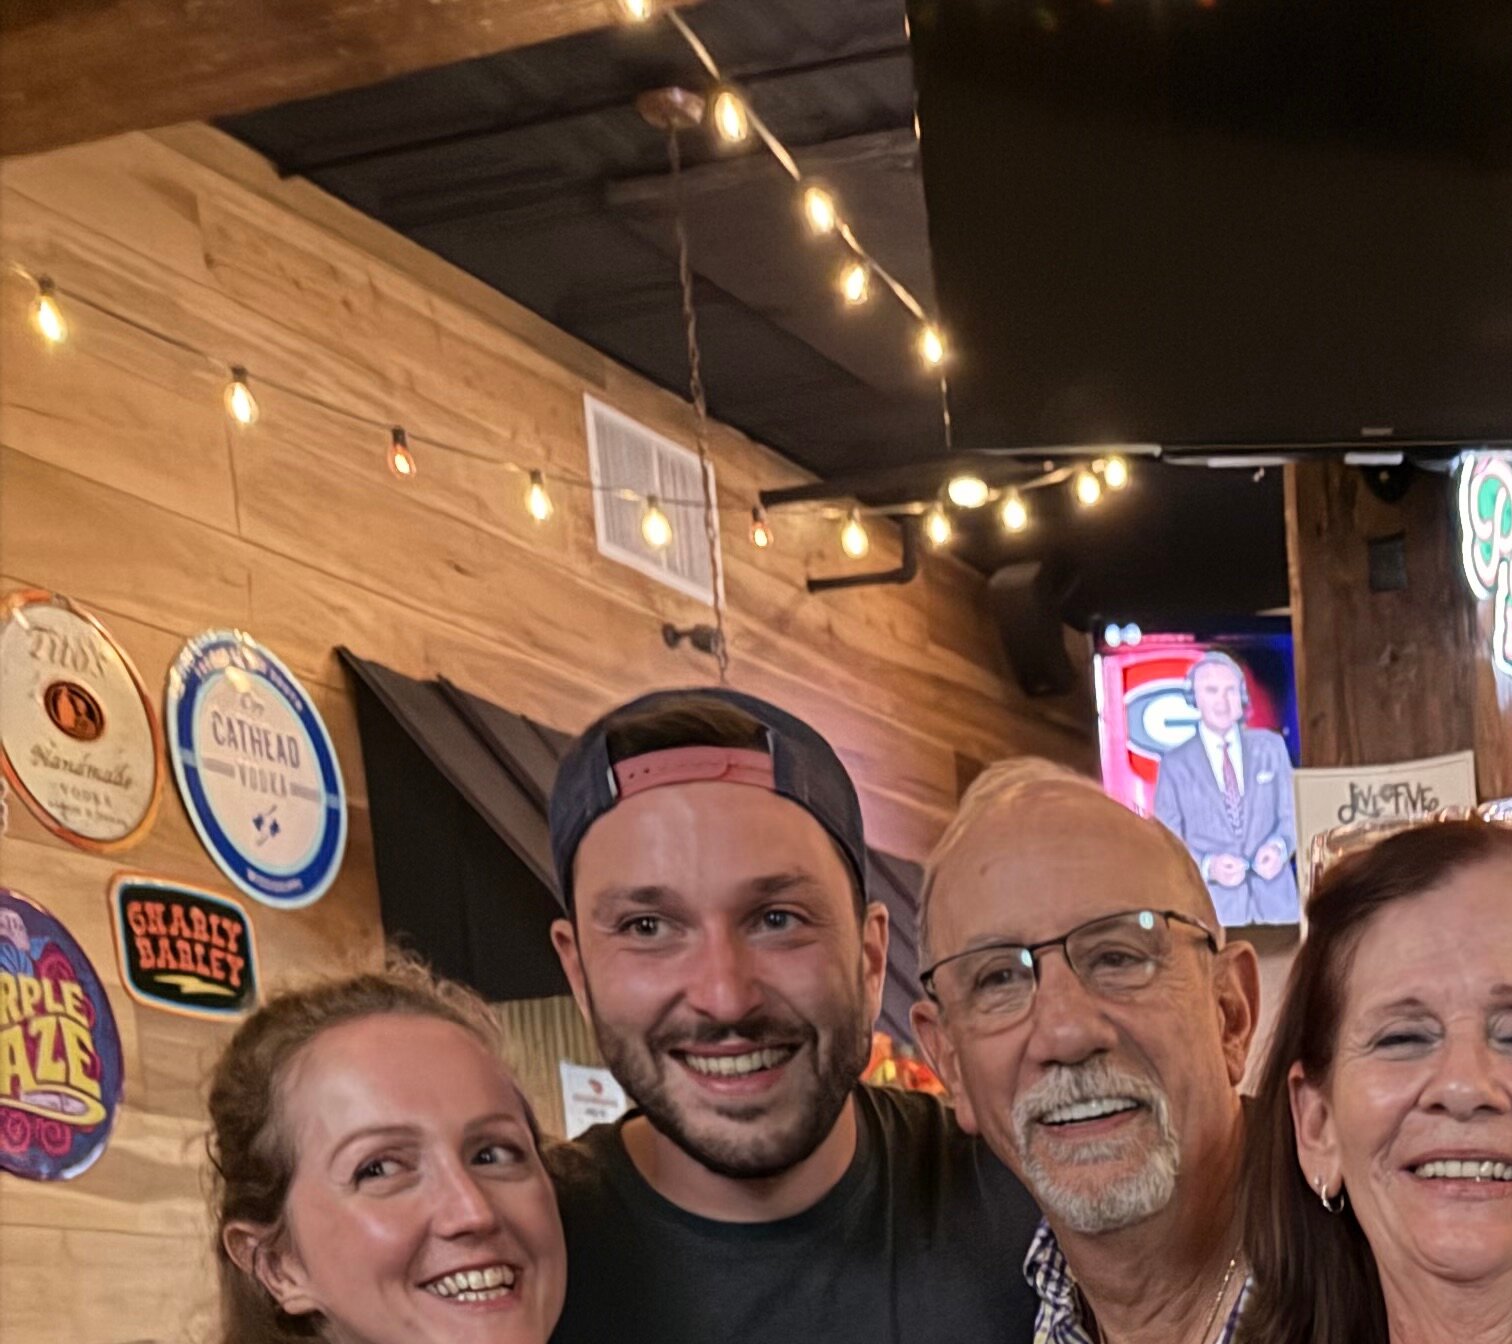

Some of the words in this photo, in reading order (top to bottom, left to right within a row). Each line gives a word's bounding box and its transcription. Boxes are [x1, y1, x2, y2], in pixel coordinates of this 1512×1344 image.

[211, 710, 300, 769] CATHEAD
[236, 761, 288, 797] VODKA
[126, 901, 242, 953] GNARLY
[135, 936, 245, 988] BARLEY
